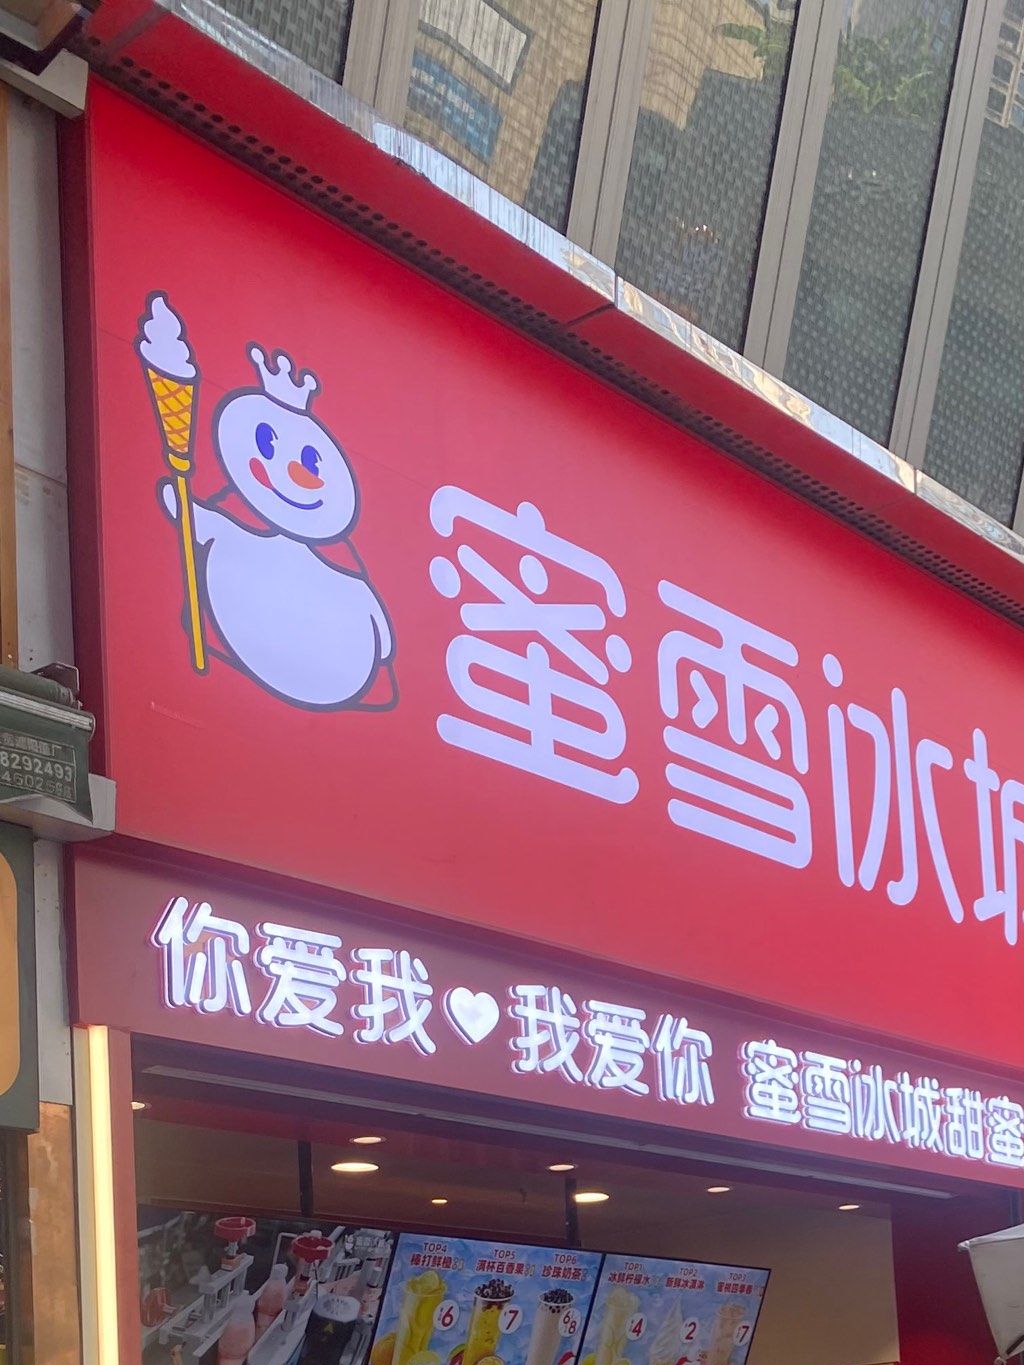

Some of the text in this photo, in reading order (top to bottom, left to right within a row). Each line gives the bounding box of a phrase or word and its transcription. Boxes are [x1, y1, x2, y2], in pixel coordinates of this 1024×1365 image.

[152, 897, 436, 1056] 你爱我
[508, 983, 714, 1105] 我爱你
[423, 1242, 447, 1253] TOP4
[493, 1249, 516, 1260] TOP5
[554, 1253, 577, 1264] TOP6
[475, 1259, 525, 1275] 满杯百香果
[541, 1264, 582, 1281] 珍珠奶茶
[679, 1267, 698, 1277] TOP2
[608, 1272, 650, 1286] 冰鲜柠檬水
